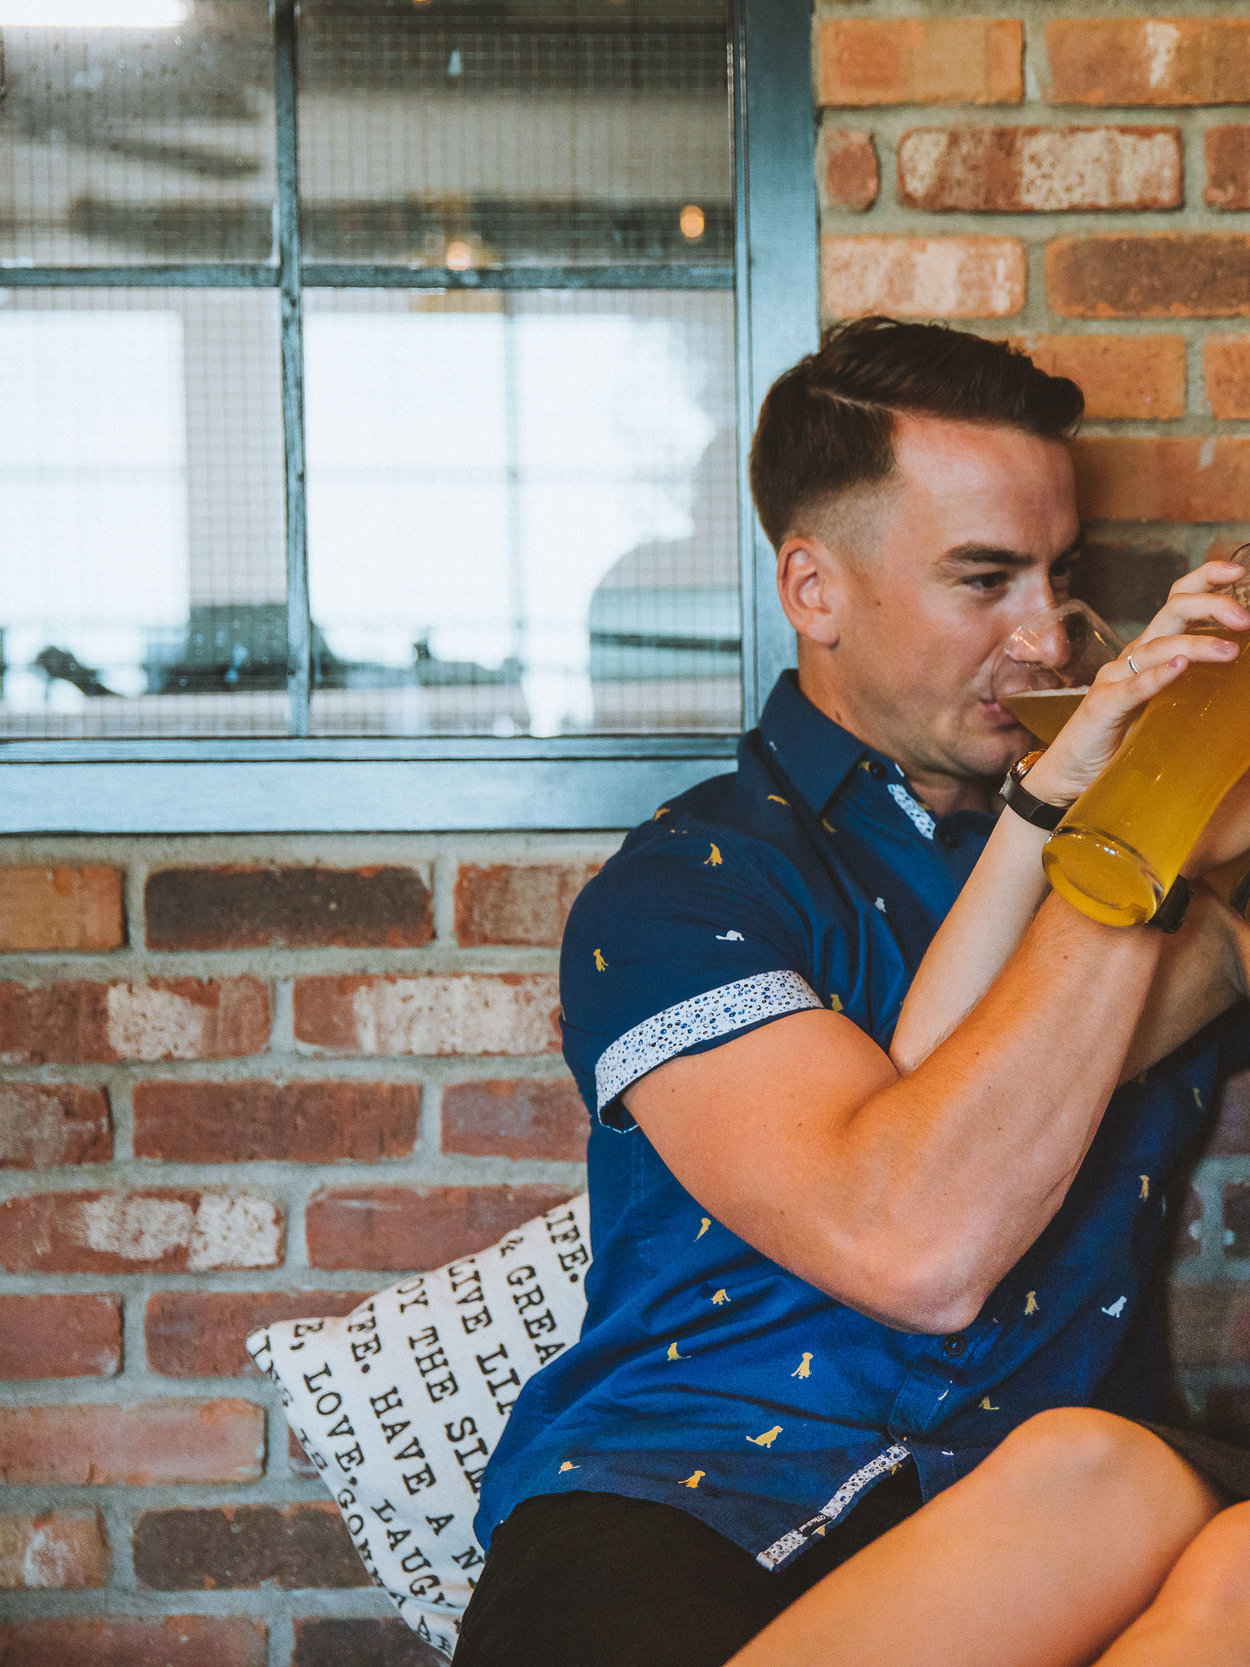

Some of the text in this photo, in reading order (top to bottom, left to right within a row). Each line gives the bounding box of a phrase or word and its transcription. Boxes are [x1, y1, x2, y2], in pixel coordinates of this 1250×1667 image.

[448, 1258, 493, 1334] LIVE
[408, 1326, 459, 1403] THE
[303, 1362, 365, 1486] LOVE,
[369, 1386, 437, 1496] HAVE
[425, 1514, 455, 1536] A
